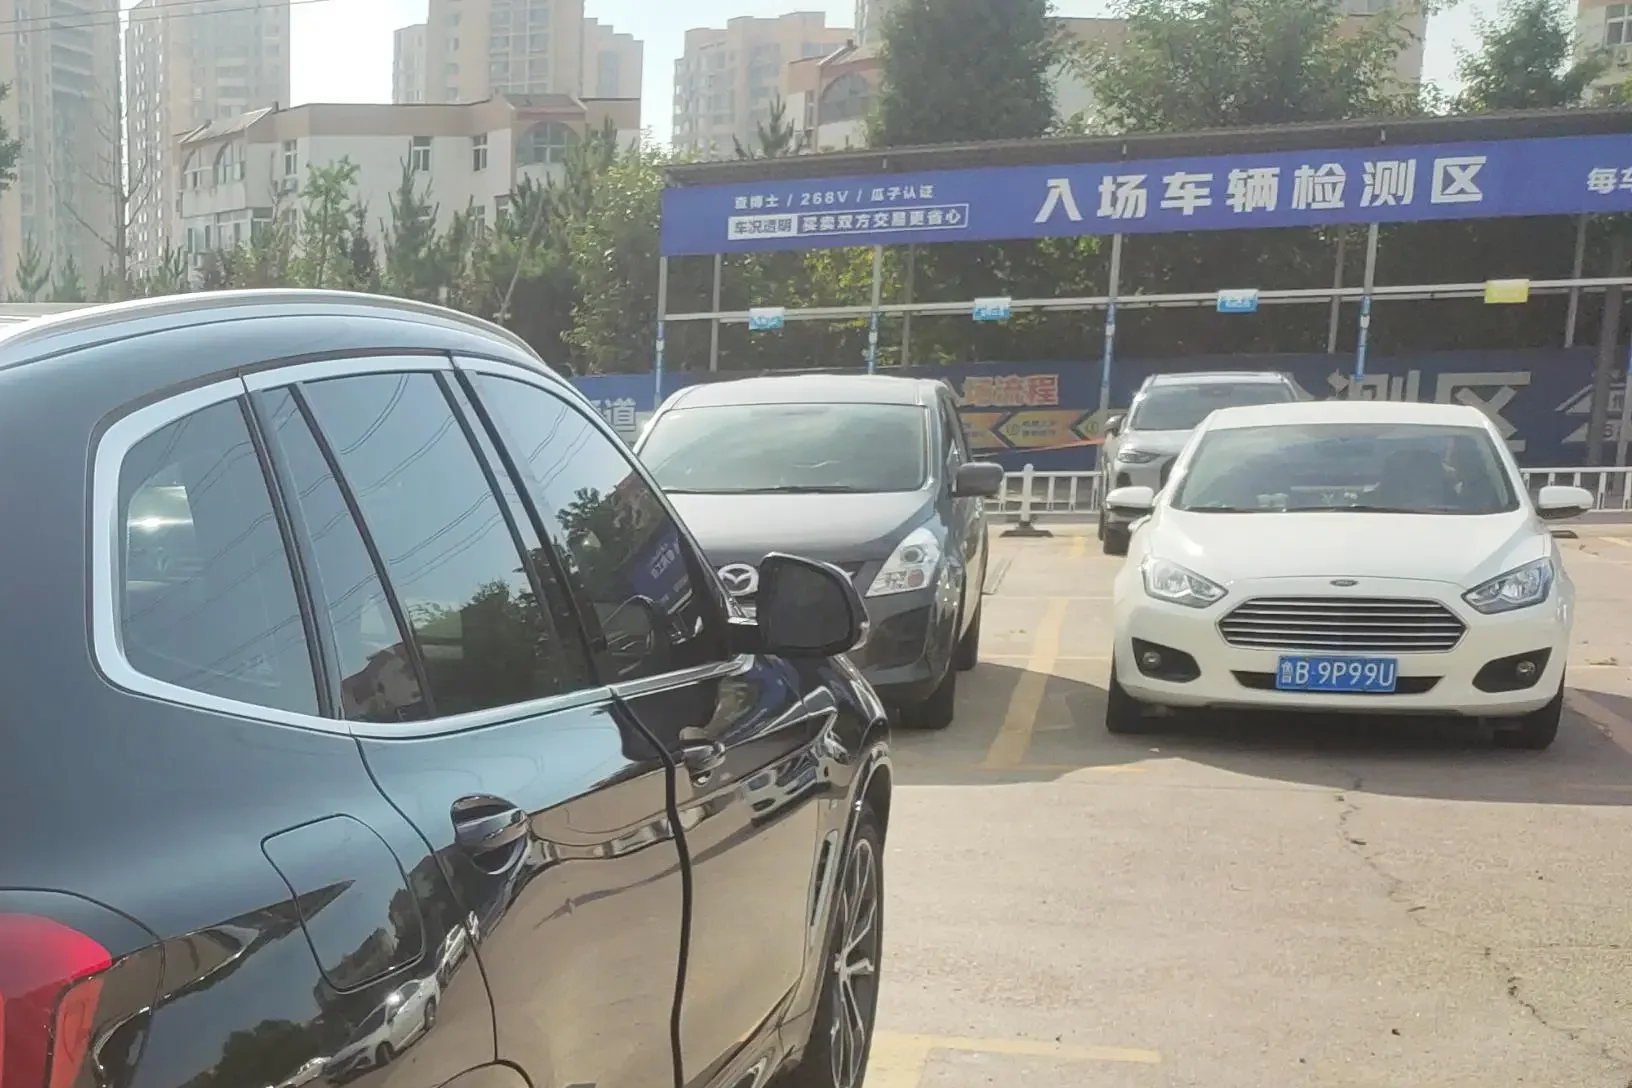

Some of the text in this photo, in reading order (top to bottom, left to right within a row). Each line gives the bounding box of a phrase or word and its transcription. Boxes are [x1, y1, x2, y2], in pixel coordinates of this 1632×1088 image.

[800, 190, 849, 206] 268V
[870, 184, 934, 201] 瓜子认证
[1033, 154, 1489, 223] 入场车辆检测区
